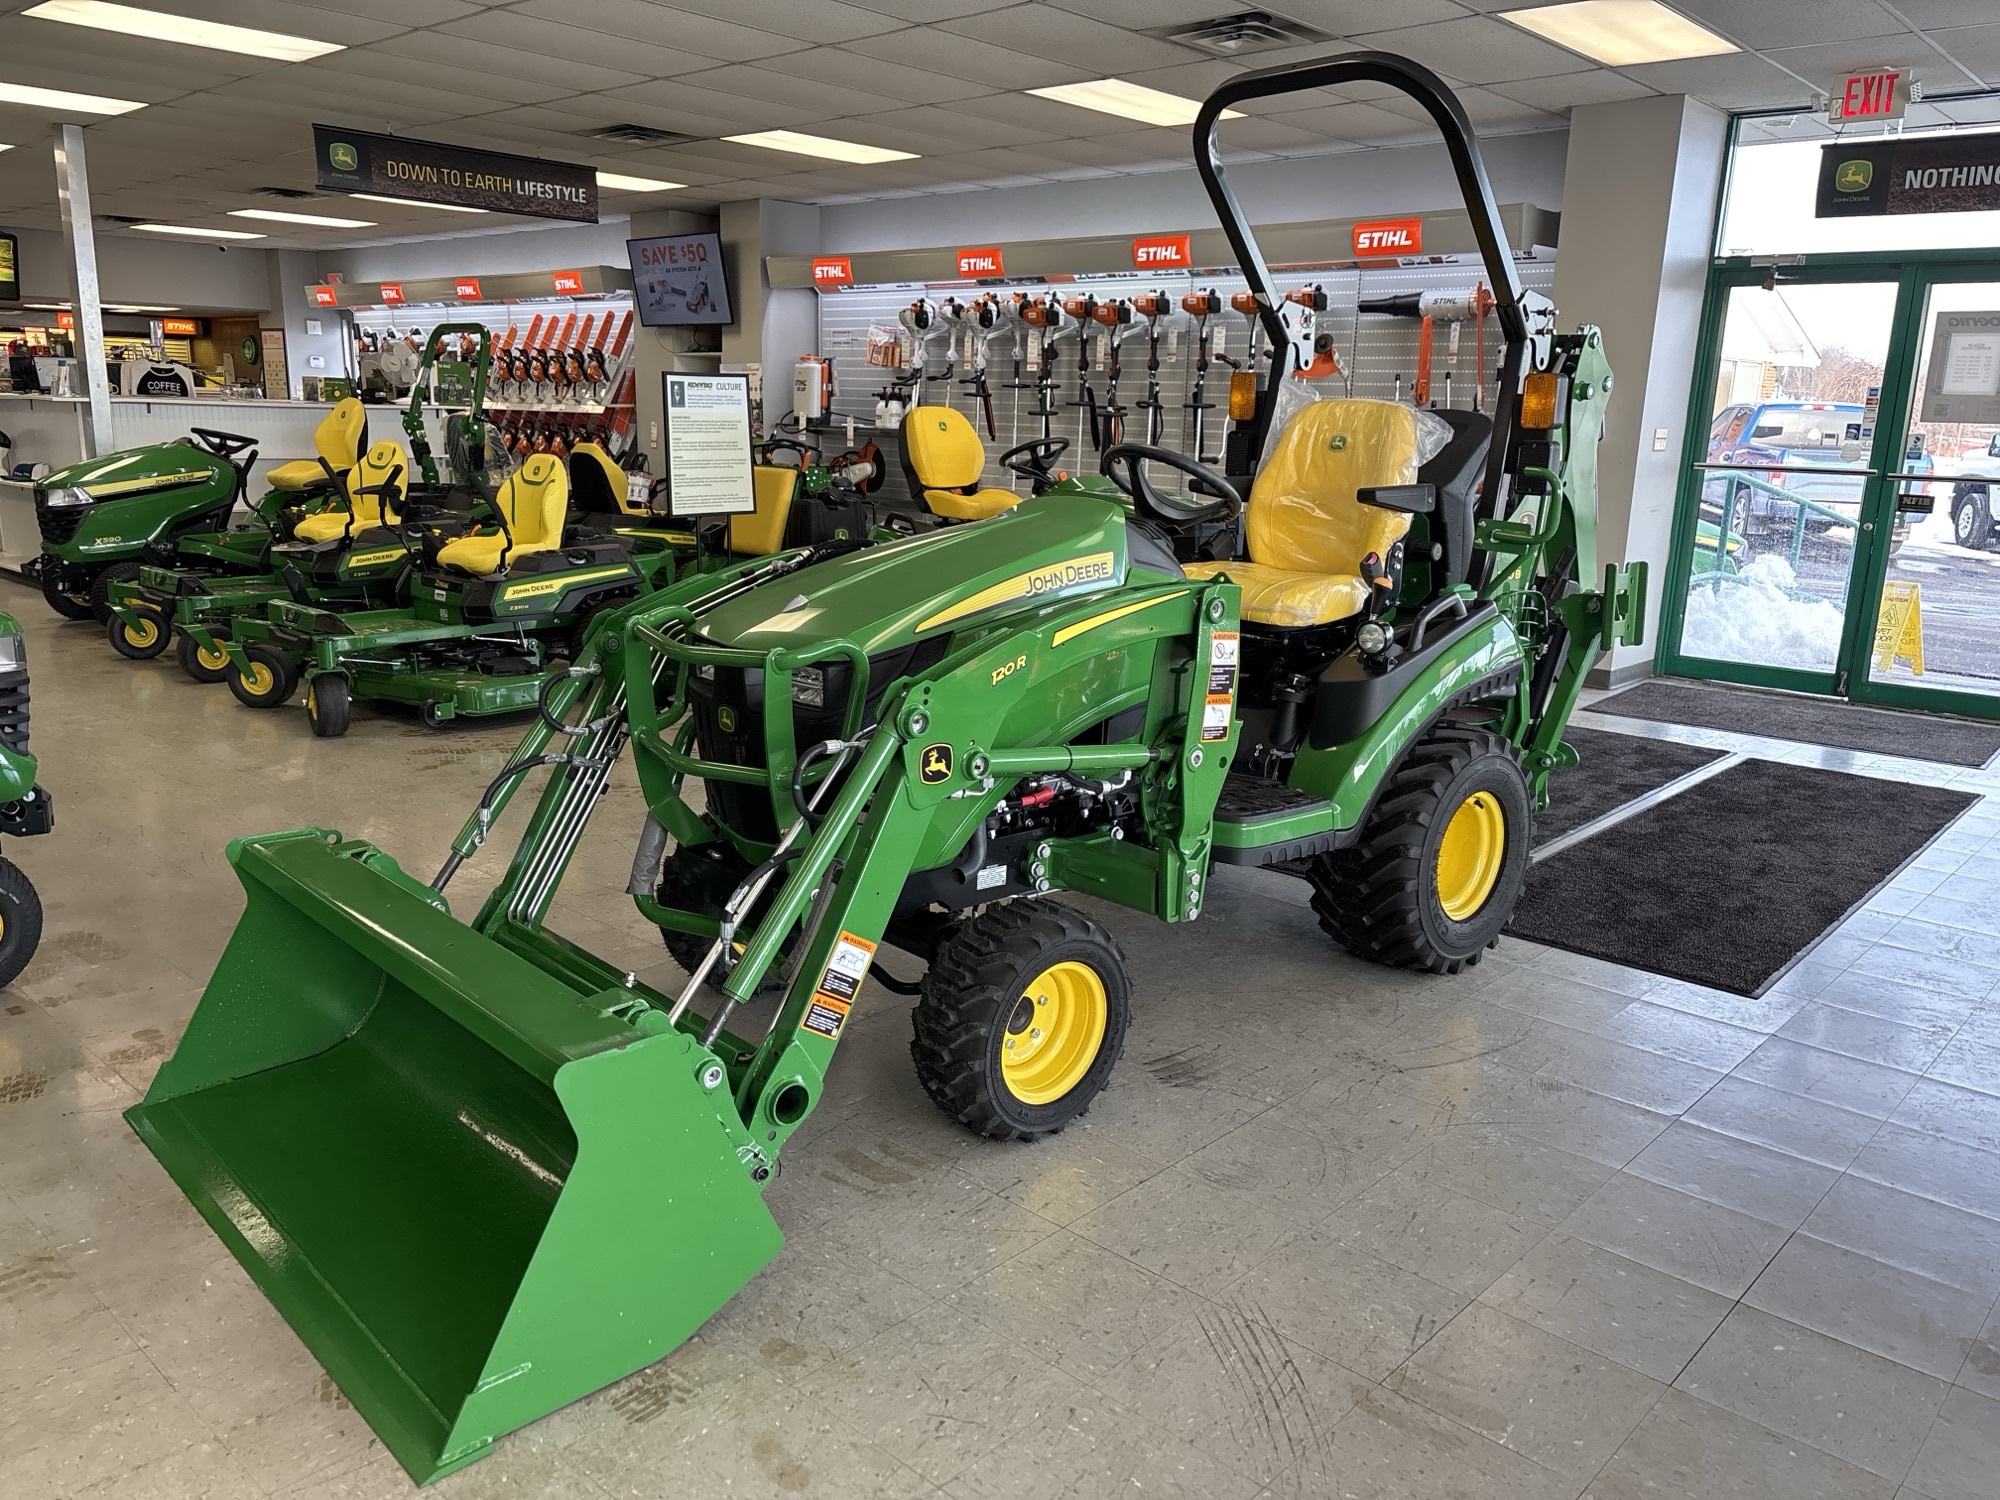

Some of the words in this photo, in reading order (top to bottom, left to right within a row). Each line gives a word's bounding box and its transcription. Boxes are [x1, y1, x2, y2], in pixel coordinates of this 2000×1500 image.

[1843, 73, 1899, 116] EXIT
[387, 161, 438, 184] DOWN
[440, 168, 460, 186] TO
[465, 172, 512, 193] EARTH
[516, 180, 587, 203] LIFESTYLE
[1904, 165, 2000, 189] NOTHIN
[1357, 230, 1412, 249] STIHL
[641, 245, 678, 266] SAVE
[681, 242, 707, 263] $50
[1137, 246, 1181, 261] STIHL
[960, 257, 996, 272] STIHL
[815, 265, 846, 279] STIHL
[457, 285, 476, 296] STIHL
[555, 278, 578, 291] STIHL
[317, 293, 332, 303] STIHL
[382, 289, 399, 299] STIHL
[1433, 297, 1458, 305] STIHL
[167, 322, 195, 331] STIHL
[147, 381, 181, 391] COFFEE
[716, 382, 742, 391] CULTURE
[155, 477, 172, 485] JOHN
[173, 473, 195, 482] DEERE
[95, 536, 122, 545] X590
[373, 553, 394, 561] DEERE
[1026, 571, 1063, 595] JOHN
[1065, 562, 1109, 583] DEERE
[511, 587, 530, 596] JOHN
[531, 584, 554, 592] DEERE
[850, 937, 872, 950] WARNING
[823, 999, 845, 1012] WARNING
